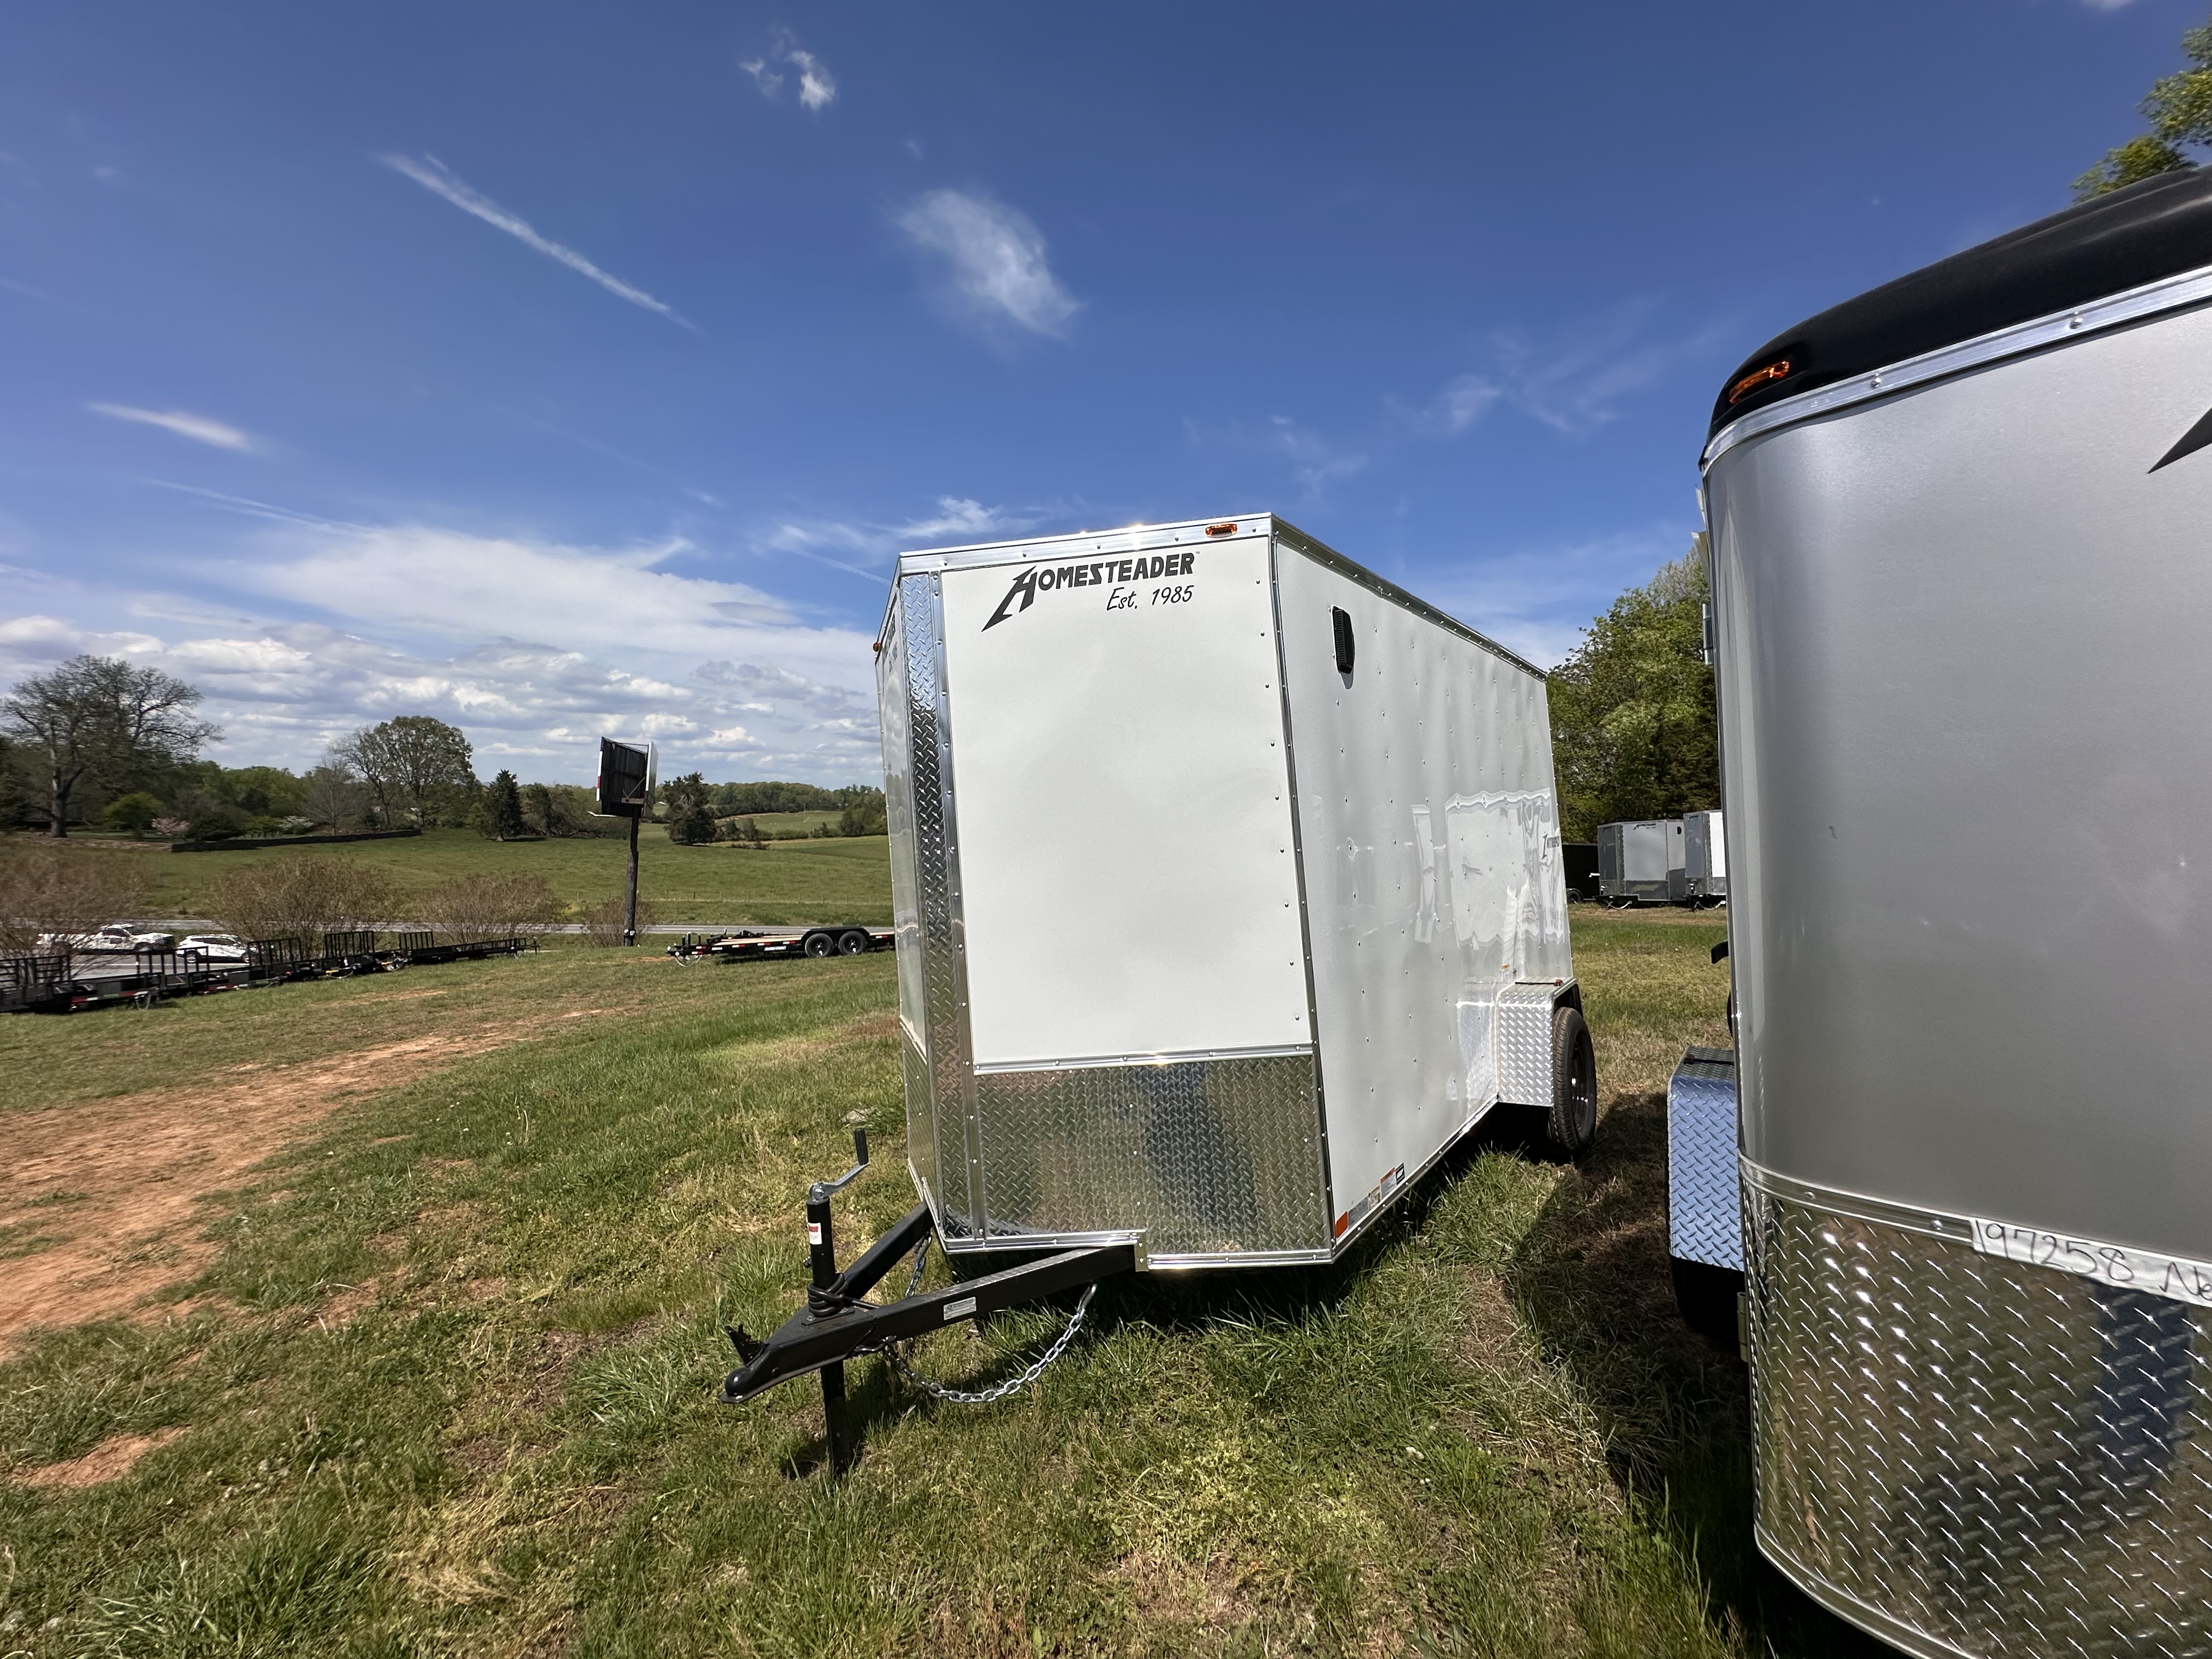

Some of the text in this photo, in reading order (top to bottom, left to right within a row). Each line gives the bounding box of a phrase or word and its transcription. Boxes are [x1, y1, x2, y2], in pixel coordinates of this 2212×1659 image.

[981, 552, 1195, 632] HOMESTEADER
[1107, 585, 1194, 611] Est. 1985
[1975, 1219, 2135, 1282] 197258
